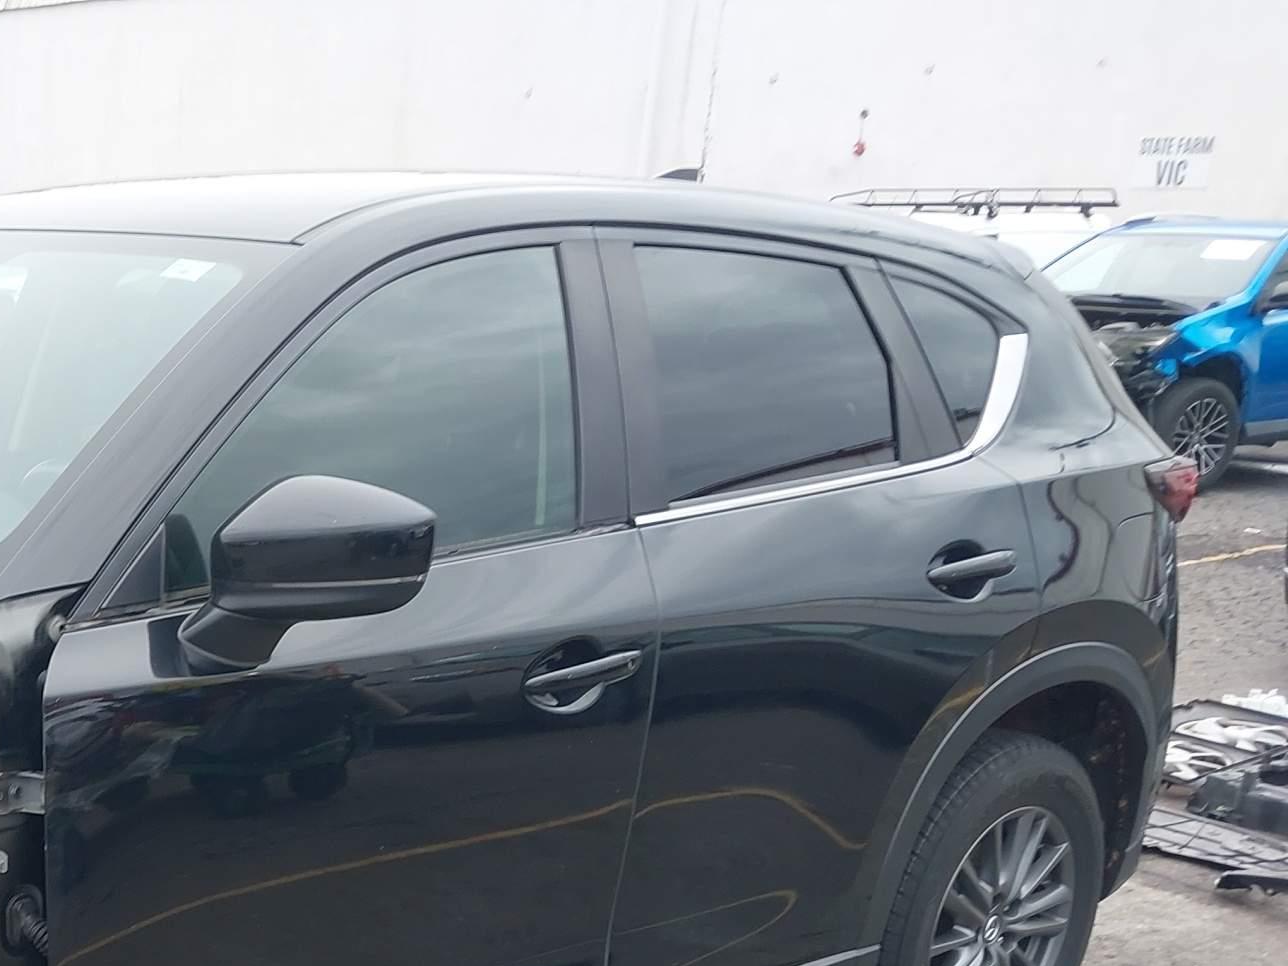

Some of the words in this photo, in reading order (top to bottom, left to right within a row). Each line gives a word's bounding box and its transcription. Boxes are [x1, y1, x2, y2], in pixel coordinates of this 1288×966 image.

[1139, 136, 1176, 155] STATE
[1176, 135, 1215, 154] FARM
[1155, 159, 1187, 186] VIC
